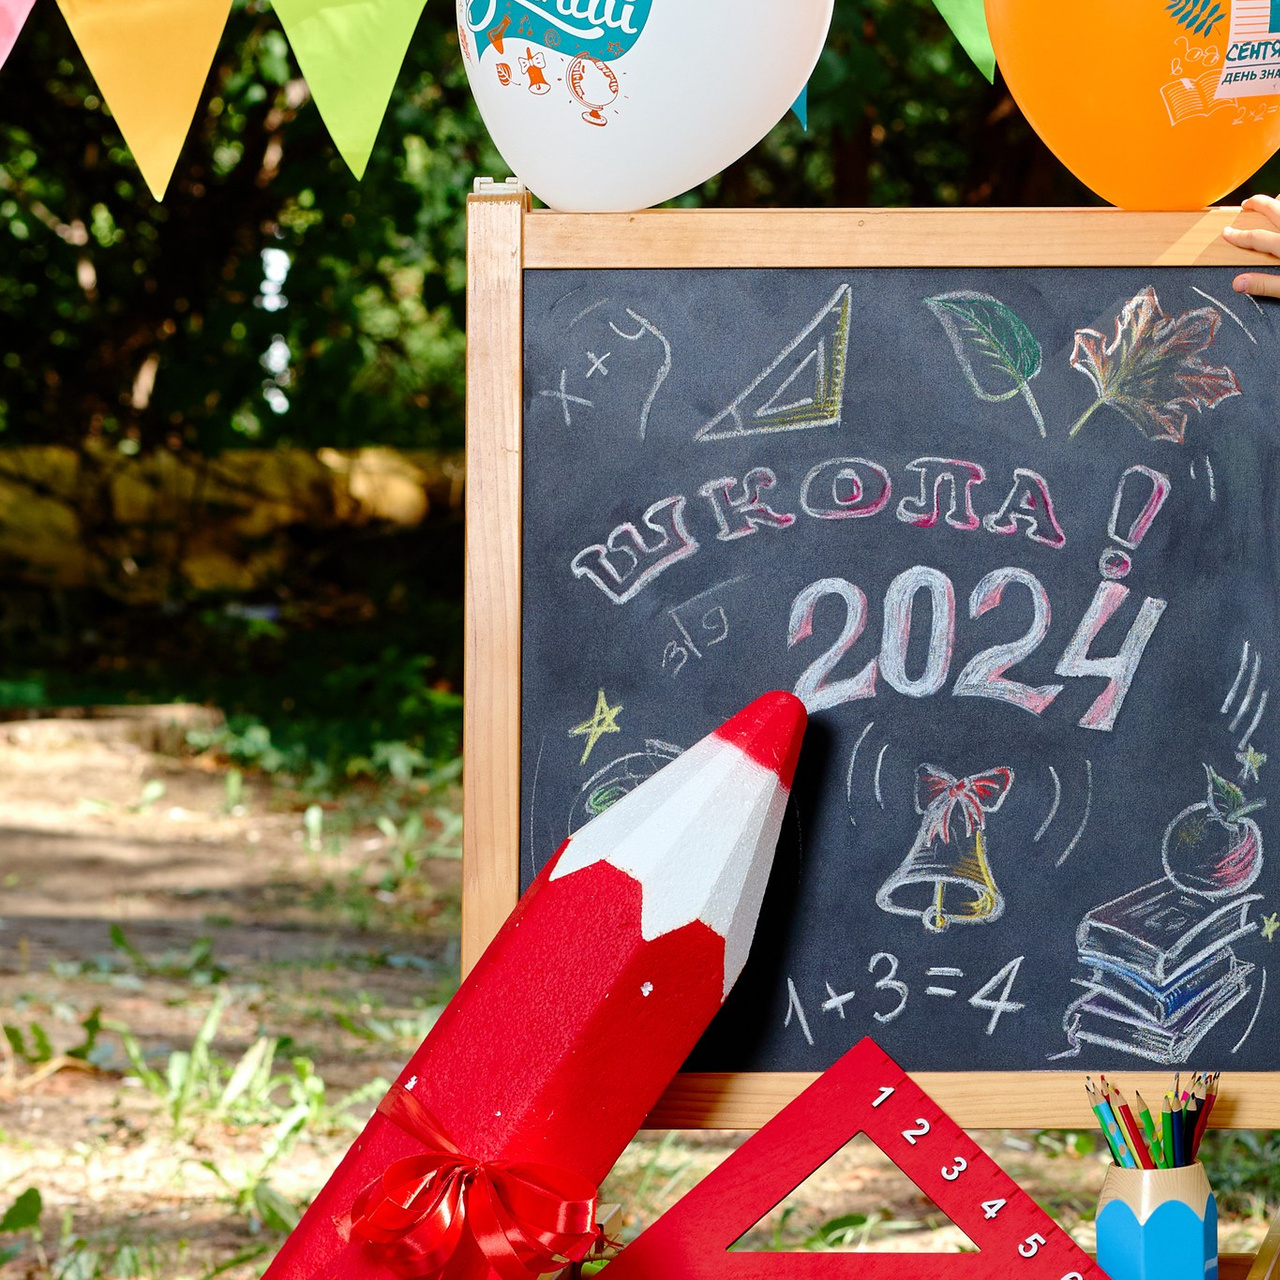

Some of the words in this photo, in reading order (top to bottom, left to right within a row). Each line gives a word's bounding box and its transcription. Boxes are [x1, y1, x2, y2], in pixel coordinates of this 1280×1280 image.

[1221, 69, 1258, 86] ДЕНЬ
[786, 564, 1168, 732] 2024
[871, 1086, 896, 1109] 1
[901, 1117, 931, 1146] 2
[940, 1156, 968, 1182] 3
[980, 1198, 1007, 1221] 4
[1017, 1232, 1047, 1259] 5
